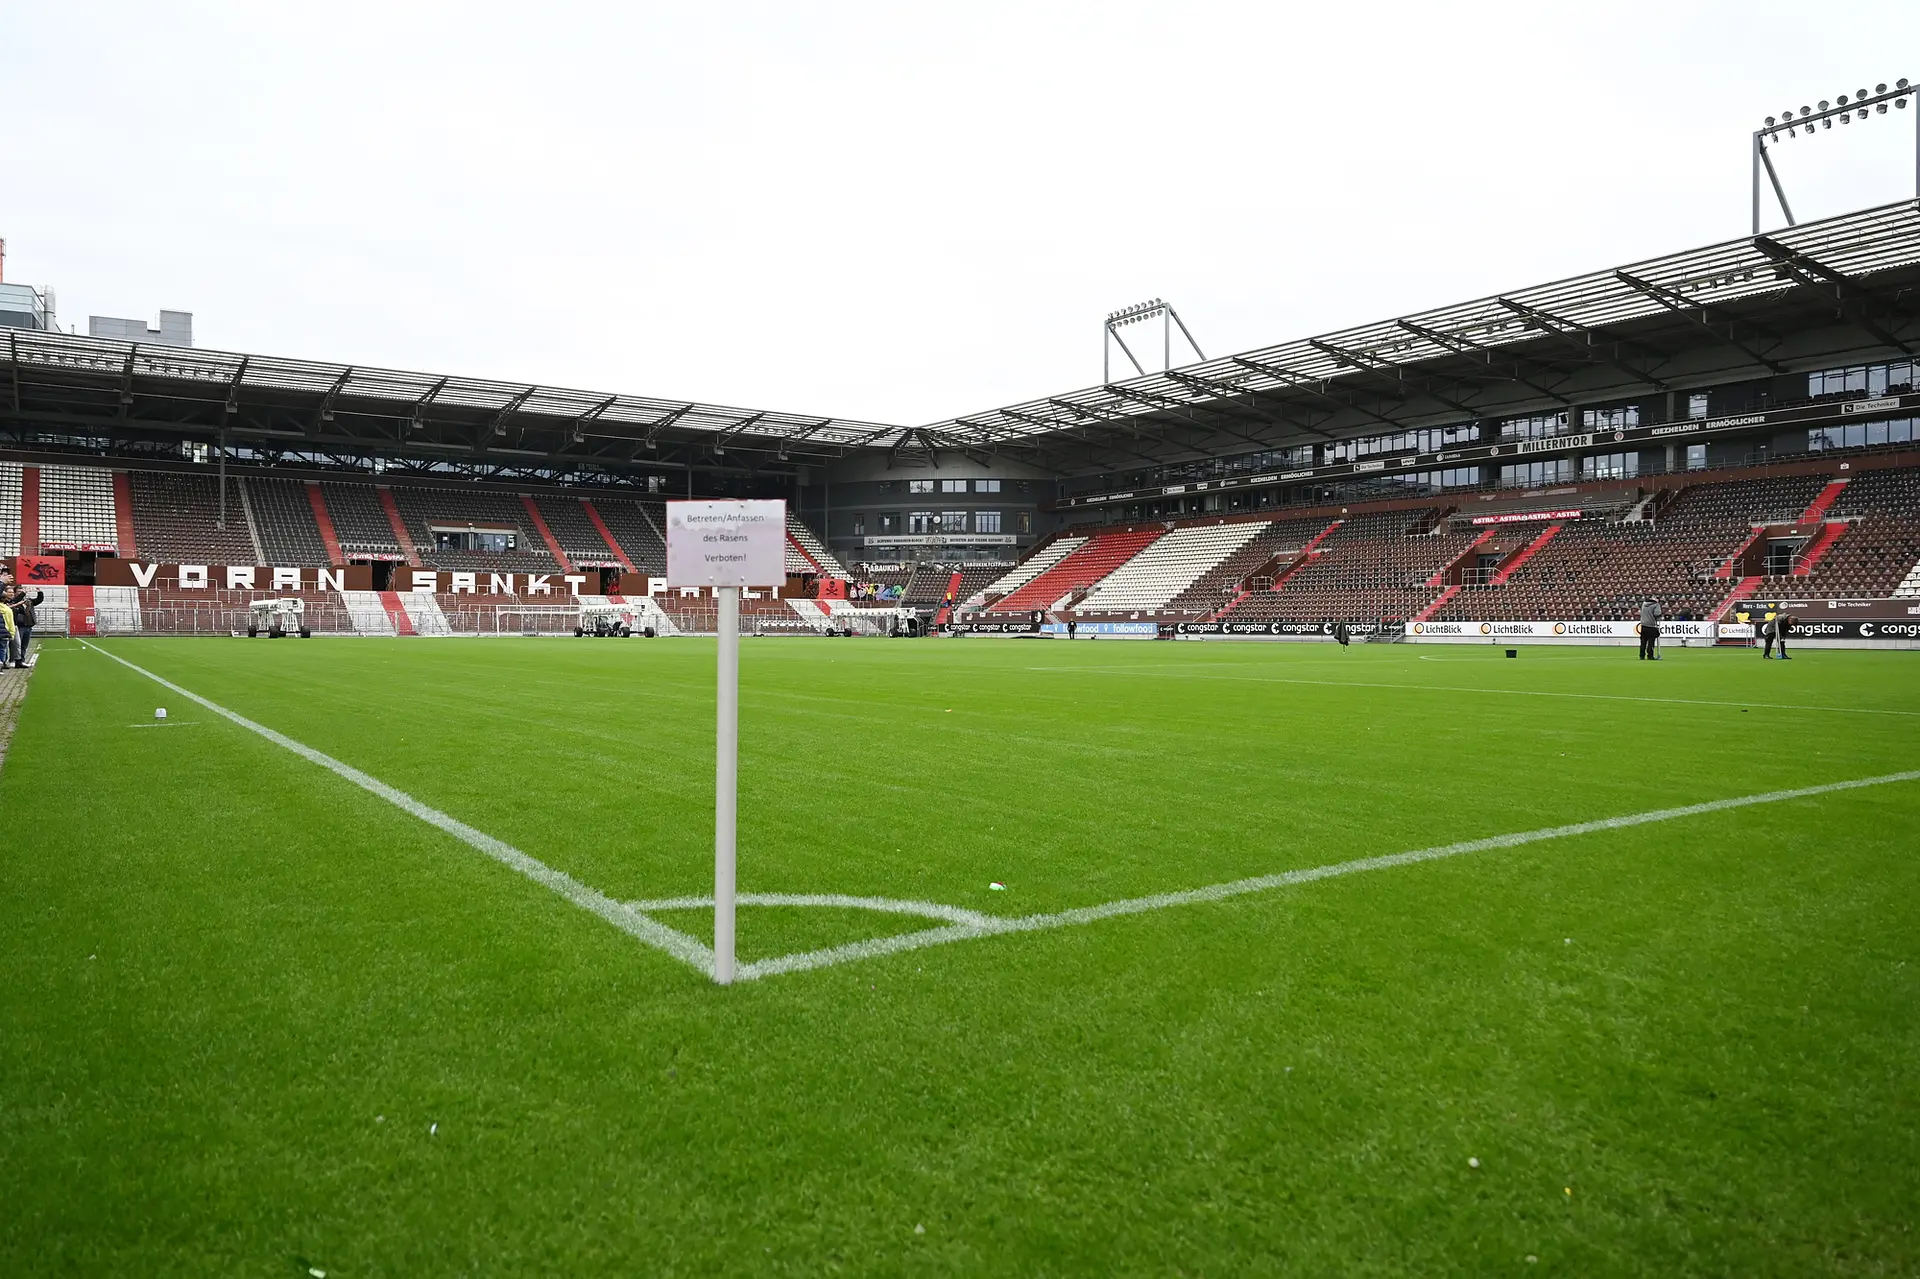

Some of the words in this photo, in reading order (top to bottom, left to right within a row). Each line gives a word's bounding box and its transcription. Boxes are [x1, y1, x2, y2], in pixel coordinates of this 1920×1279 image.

[1867, 400, 1896, 409] Techniker
[1651, 424, 1699, 435] KIEZHELDEN
[1706, 416, 1765, 429] ERMÖGLICHER
[1522, 436, 1588, 453] MILLERNTOR
[687, 514, 764, 523] Betreten/Anfassen
[1528, 513, 1551, 521] ASTRA
[1556, 510, 1580, 518] ASTRA
[703, 534, 718, 542] des
[719, 534, 748, 542] Rasens
[704, 554, 747, 562] Verboten!
[129, 563, 345, 592] VORAN
[412, 571, 586, 596] SANKT
[1187, 623, 1218, 633] congstar
[1232, 623, 1267, 634] congstar
[1282, 623, 1319, 634] congstar
[1425, 624, 1462, 634] LichtBlick
[1494, 624, 1533, 634] LichtBlick
[1568, 624, 1612, 634] LichtBlick
